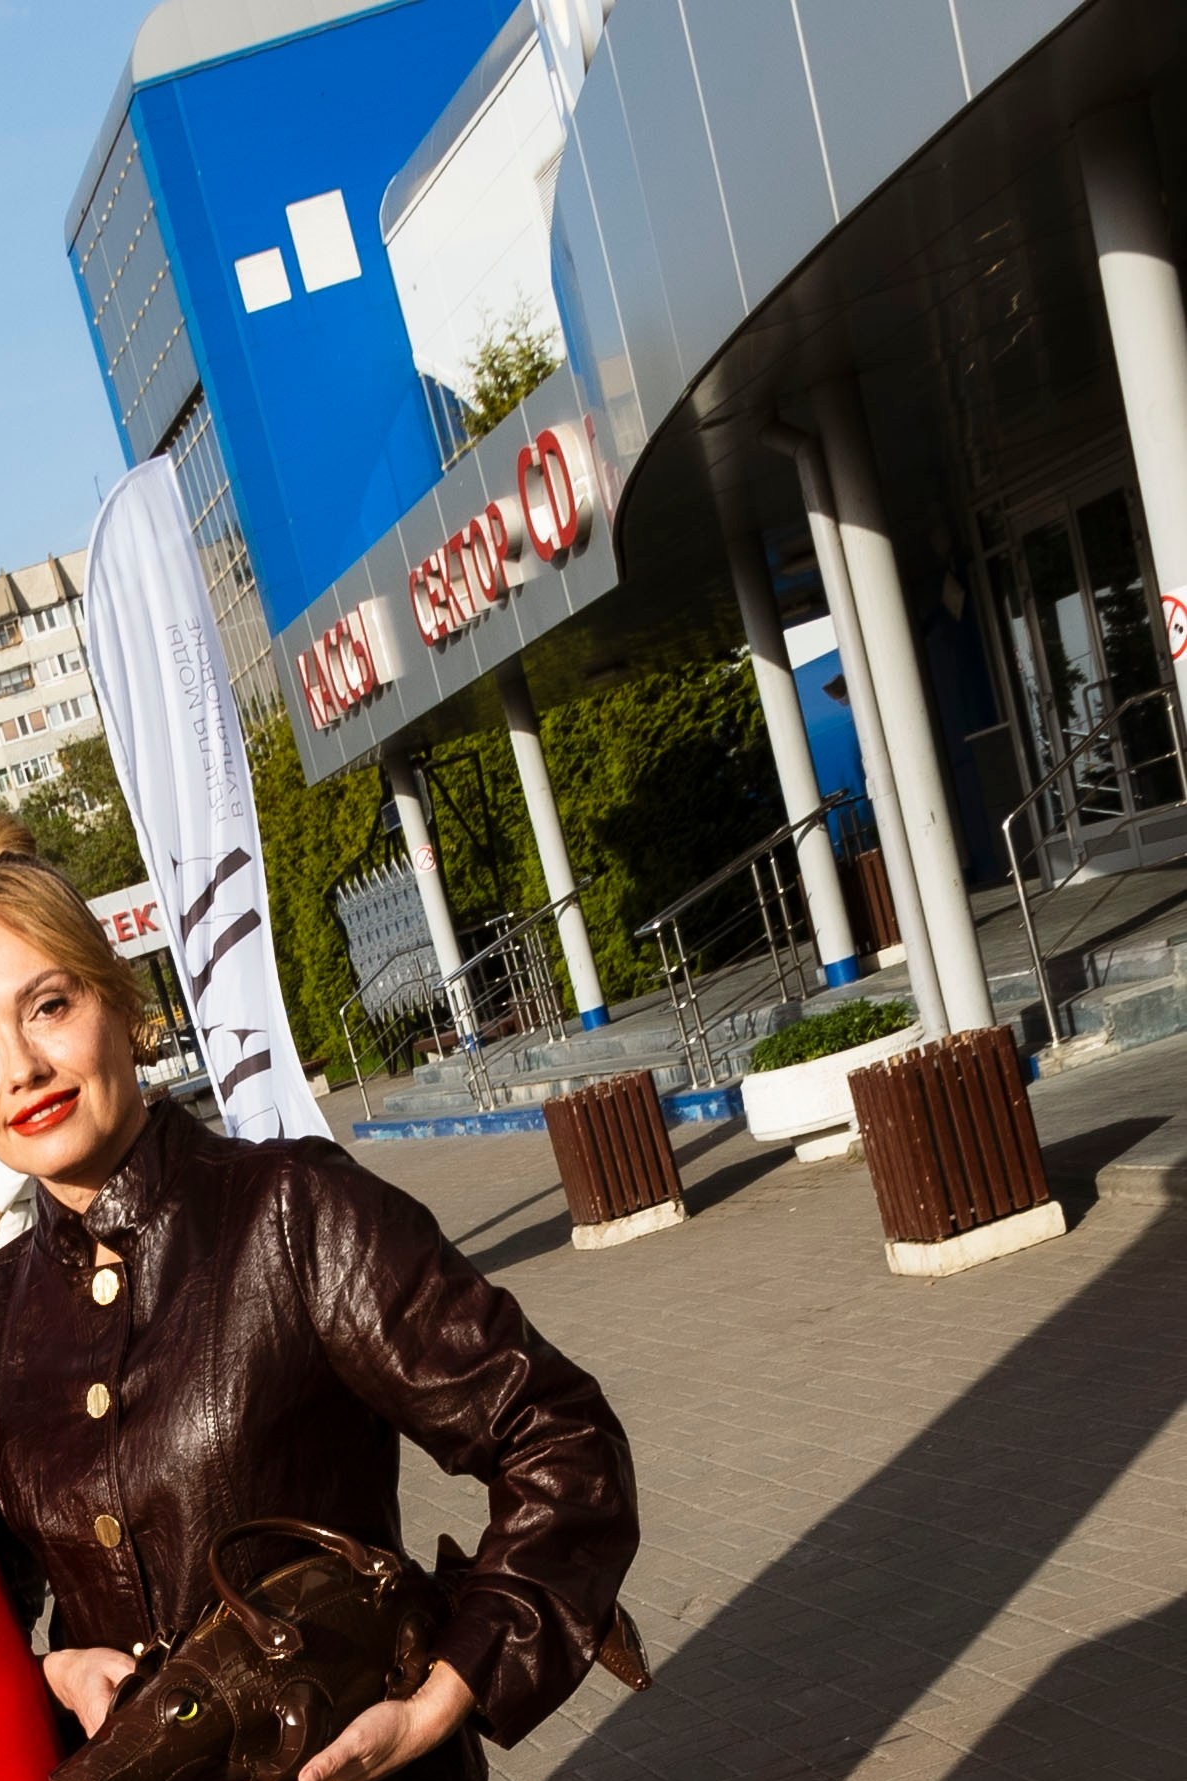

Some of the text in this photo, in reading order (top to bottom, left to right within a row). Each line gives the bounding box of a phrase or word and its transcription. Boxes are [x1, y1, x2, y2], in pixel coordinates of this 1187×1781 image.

[165, 623, 203, 710] МОДЫ
[296, 601, 384, 732] КАССЫ
[409, 501, 514, 648] СЕКТОР
